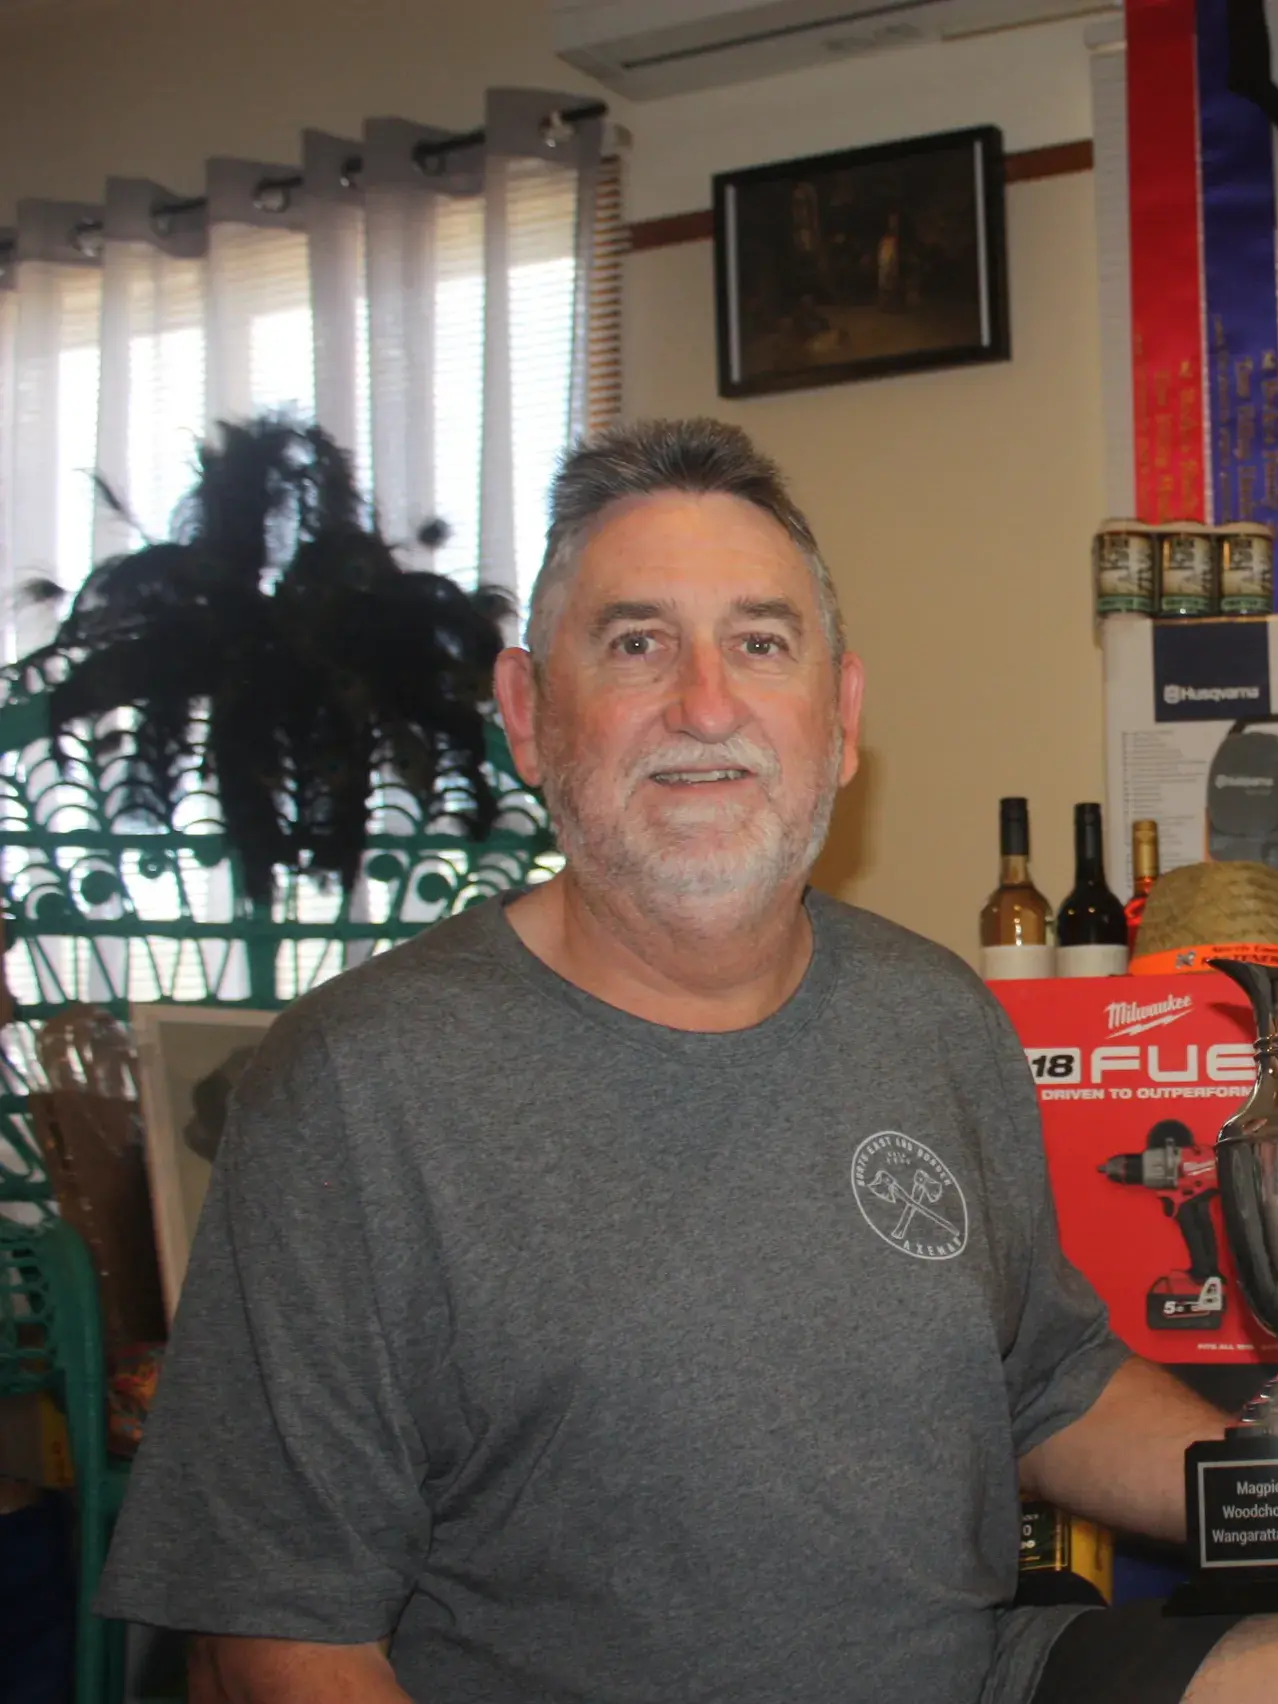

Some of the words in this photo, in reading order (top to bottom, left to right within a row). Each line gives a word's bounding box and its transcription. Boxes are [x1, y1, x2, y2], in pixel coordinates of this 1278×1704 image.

[1181, 684, 1261, 703] Husqvarna
[1102, 993, 1193, 1030] Milwaukee
[1030, 1053, 1076, 1079] 18
[1091, 1043, 1258, 1085] FUE
[1041, 1088, 1105, 1101] DRIVEN
[1108, 1088, 1133, 1100] TO
